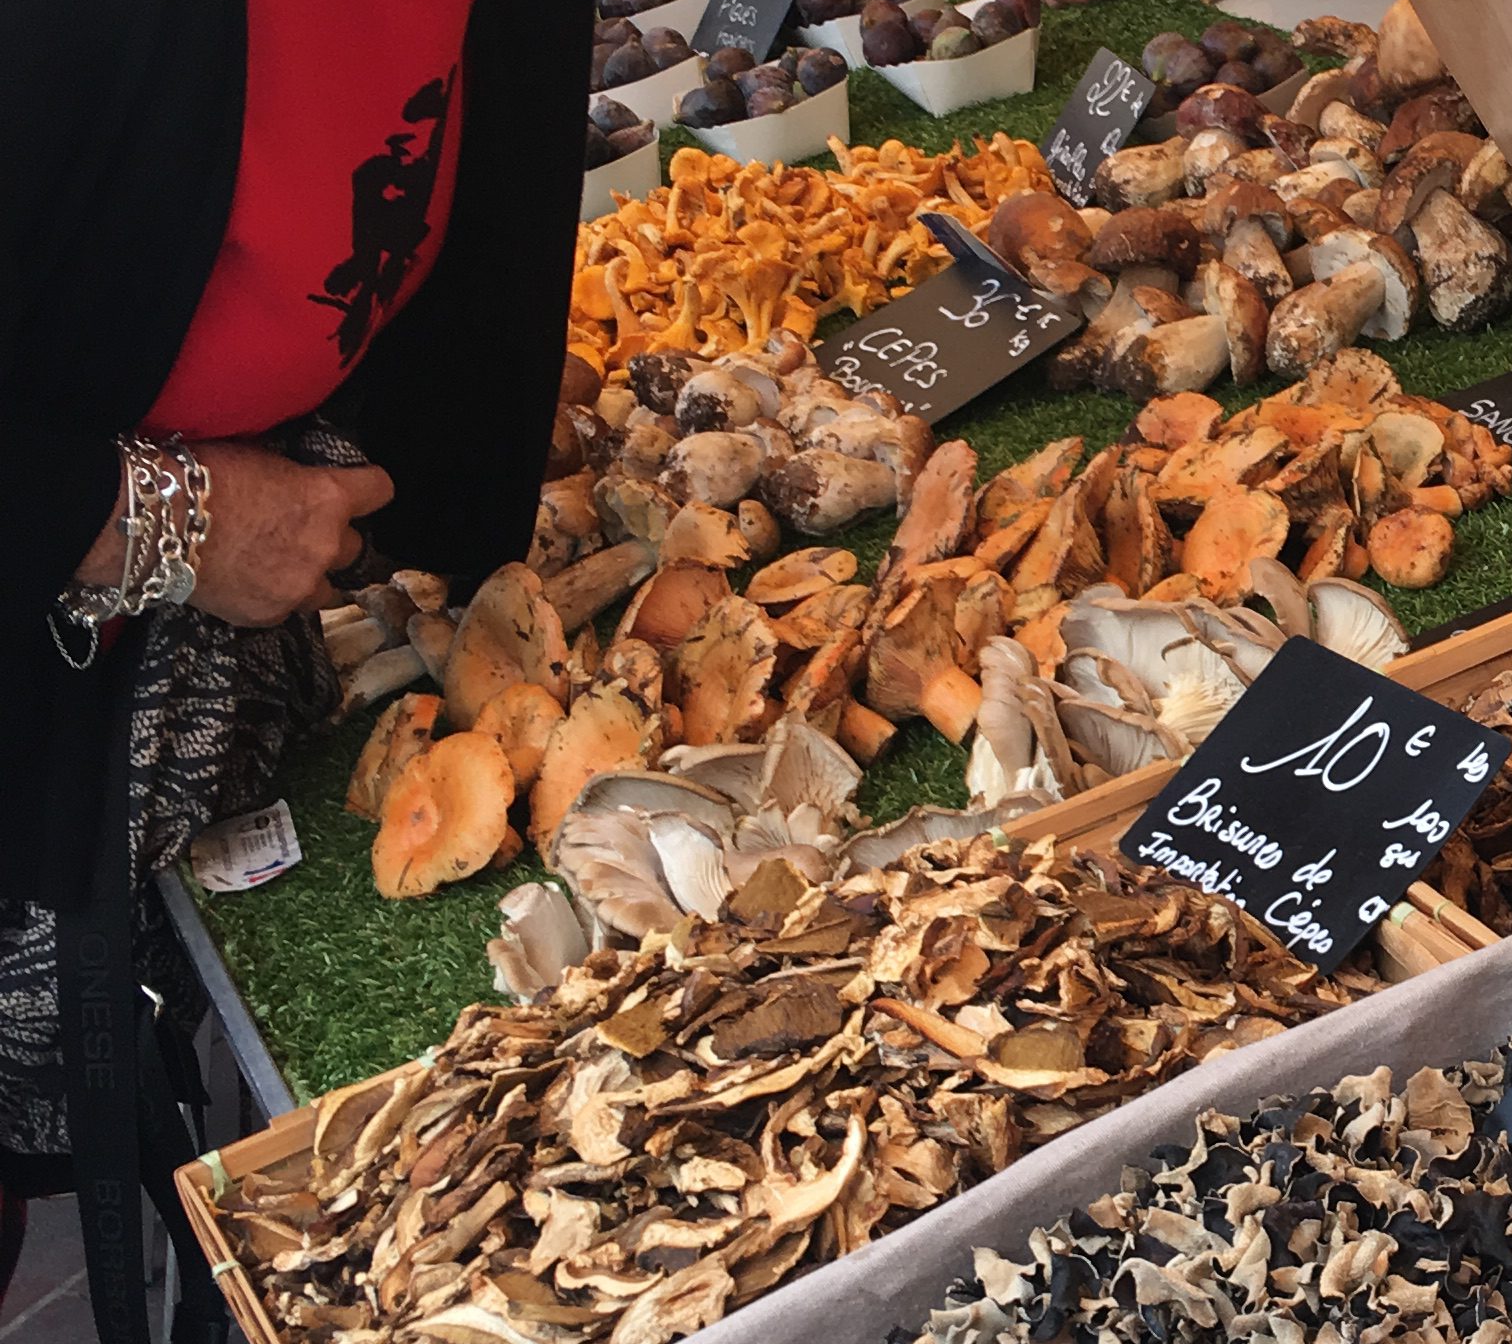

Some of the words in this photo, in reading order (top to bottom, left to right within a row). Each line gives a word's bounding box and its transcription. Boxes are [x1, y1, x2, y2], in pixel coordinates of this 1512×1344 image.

[1240, 695, 1391, 793] 10
[1382, 799, 1451, 844] 100
[1291, 849, 1338, 891] de
